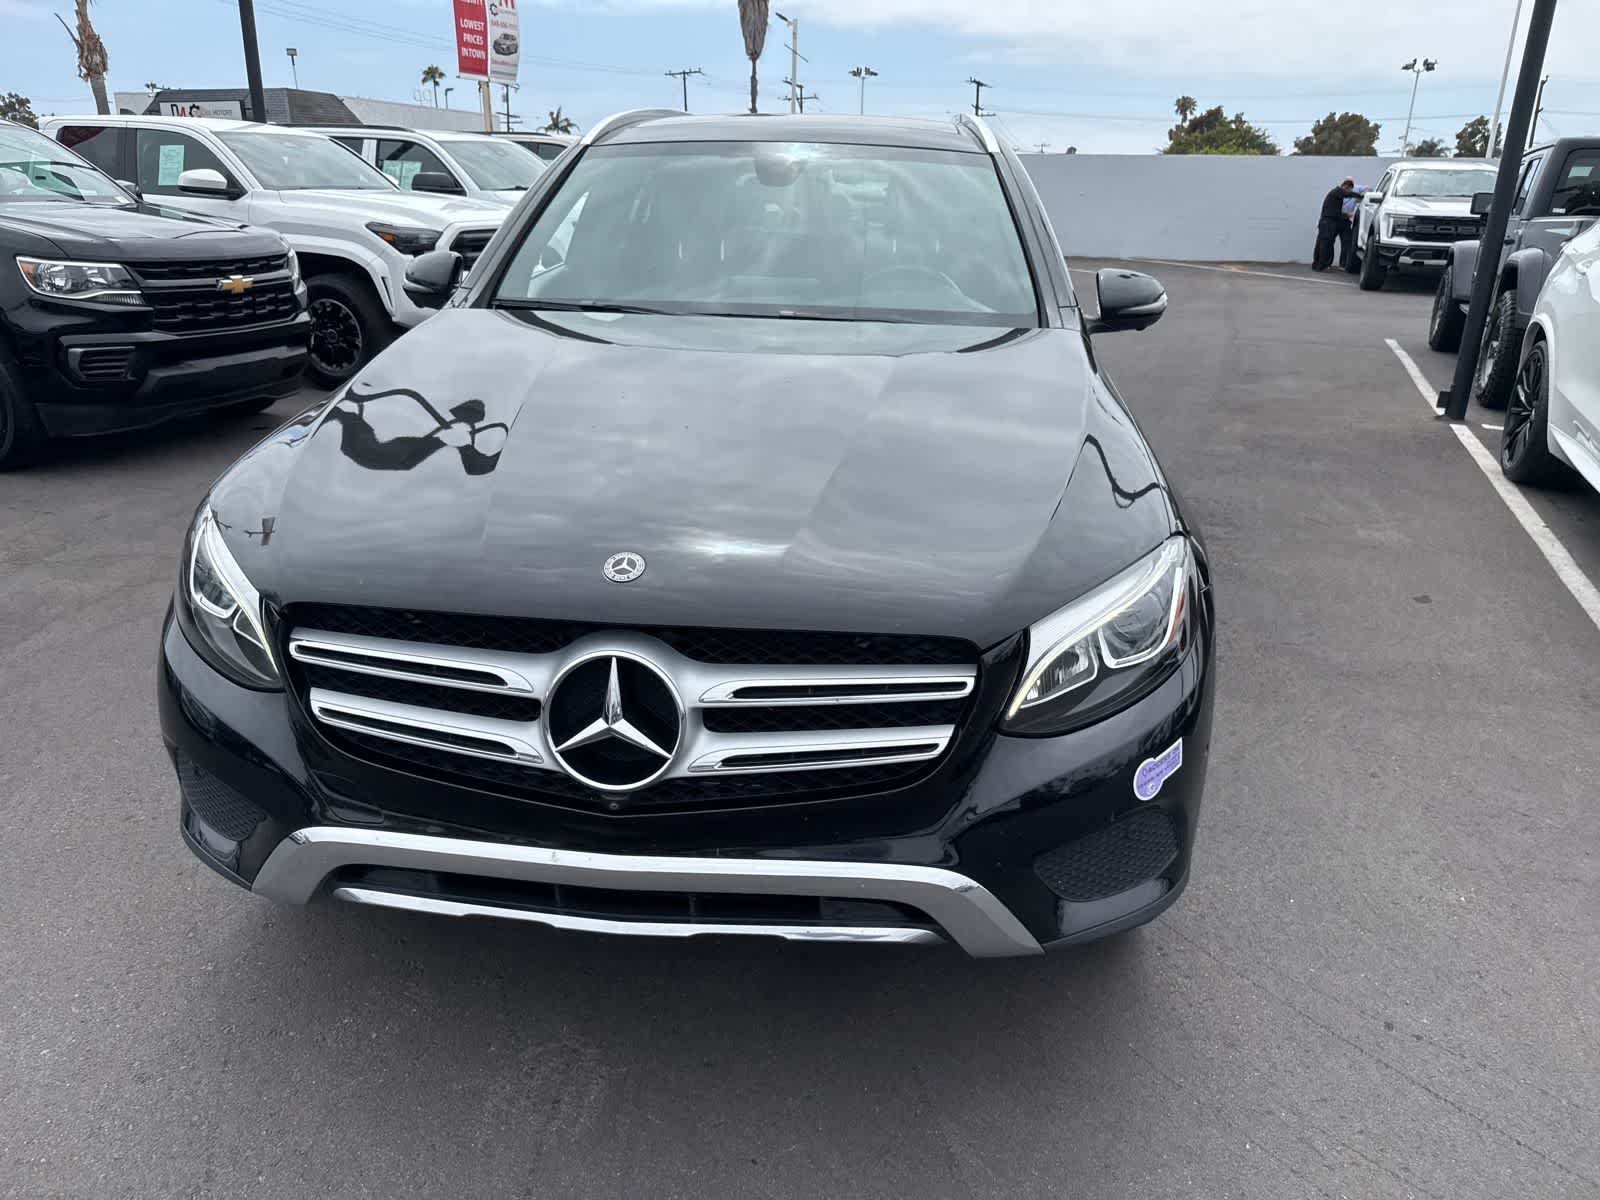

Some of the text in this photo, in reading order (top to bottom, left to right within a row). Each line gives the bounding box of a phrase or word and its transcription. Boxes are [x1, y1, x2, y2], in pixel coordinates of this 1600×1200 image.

[460, 17, 486, 32] LOWEST
[463, 32, 484, 46] PRICES
[461, 47, 486, 61] IN TOWN
